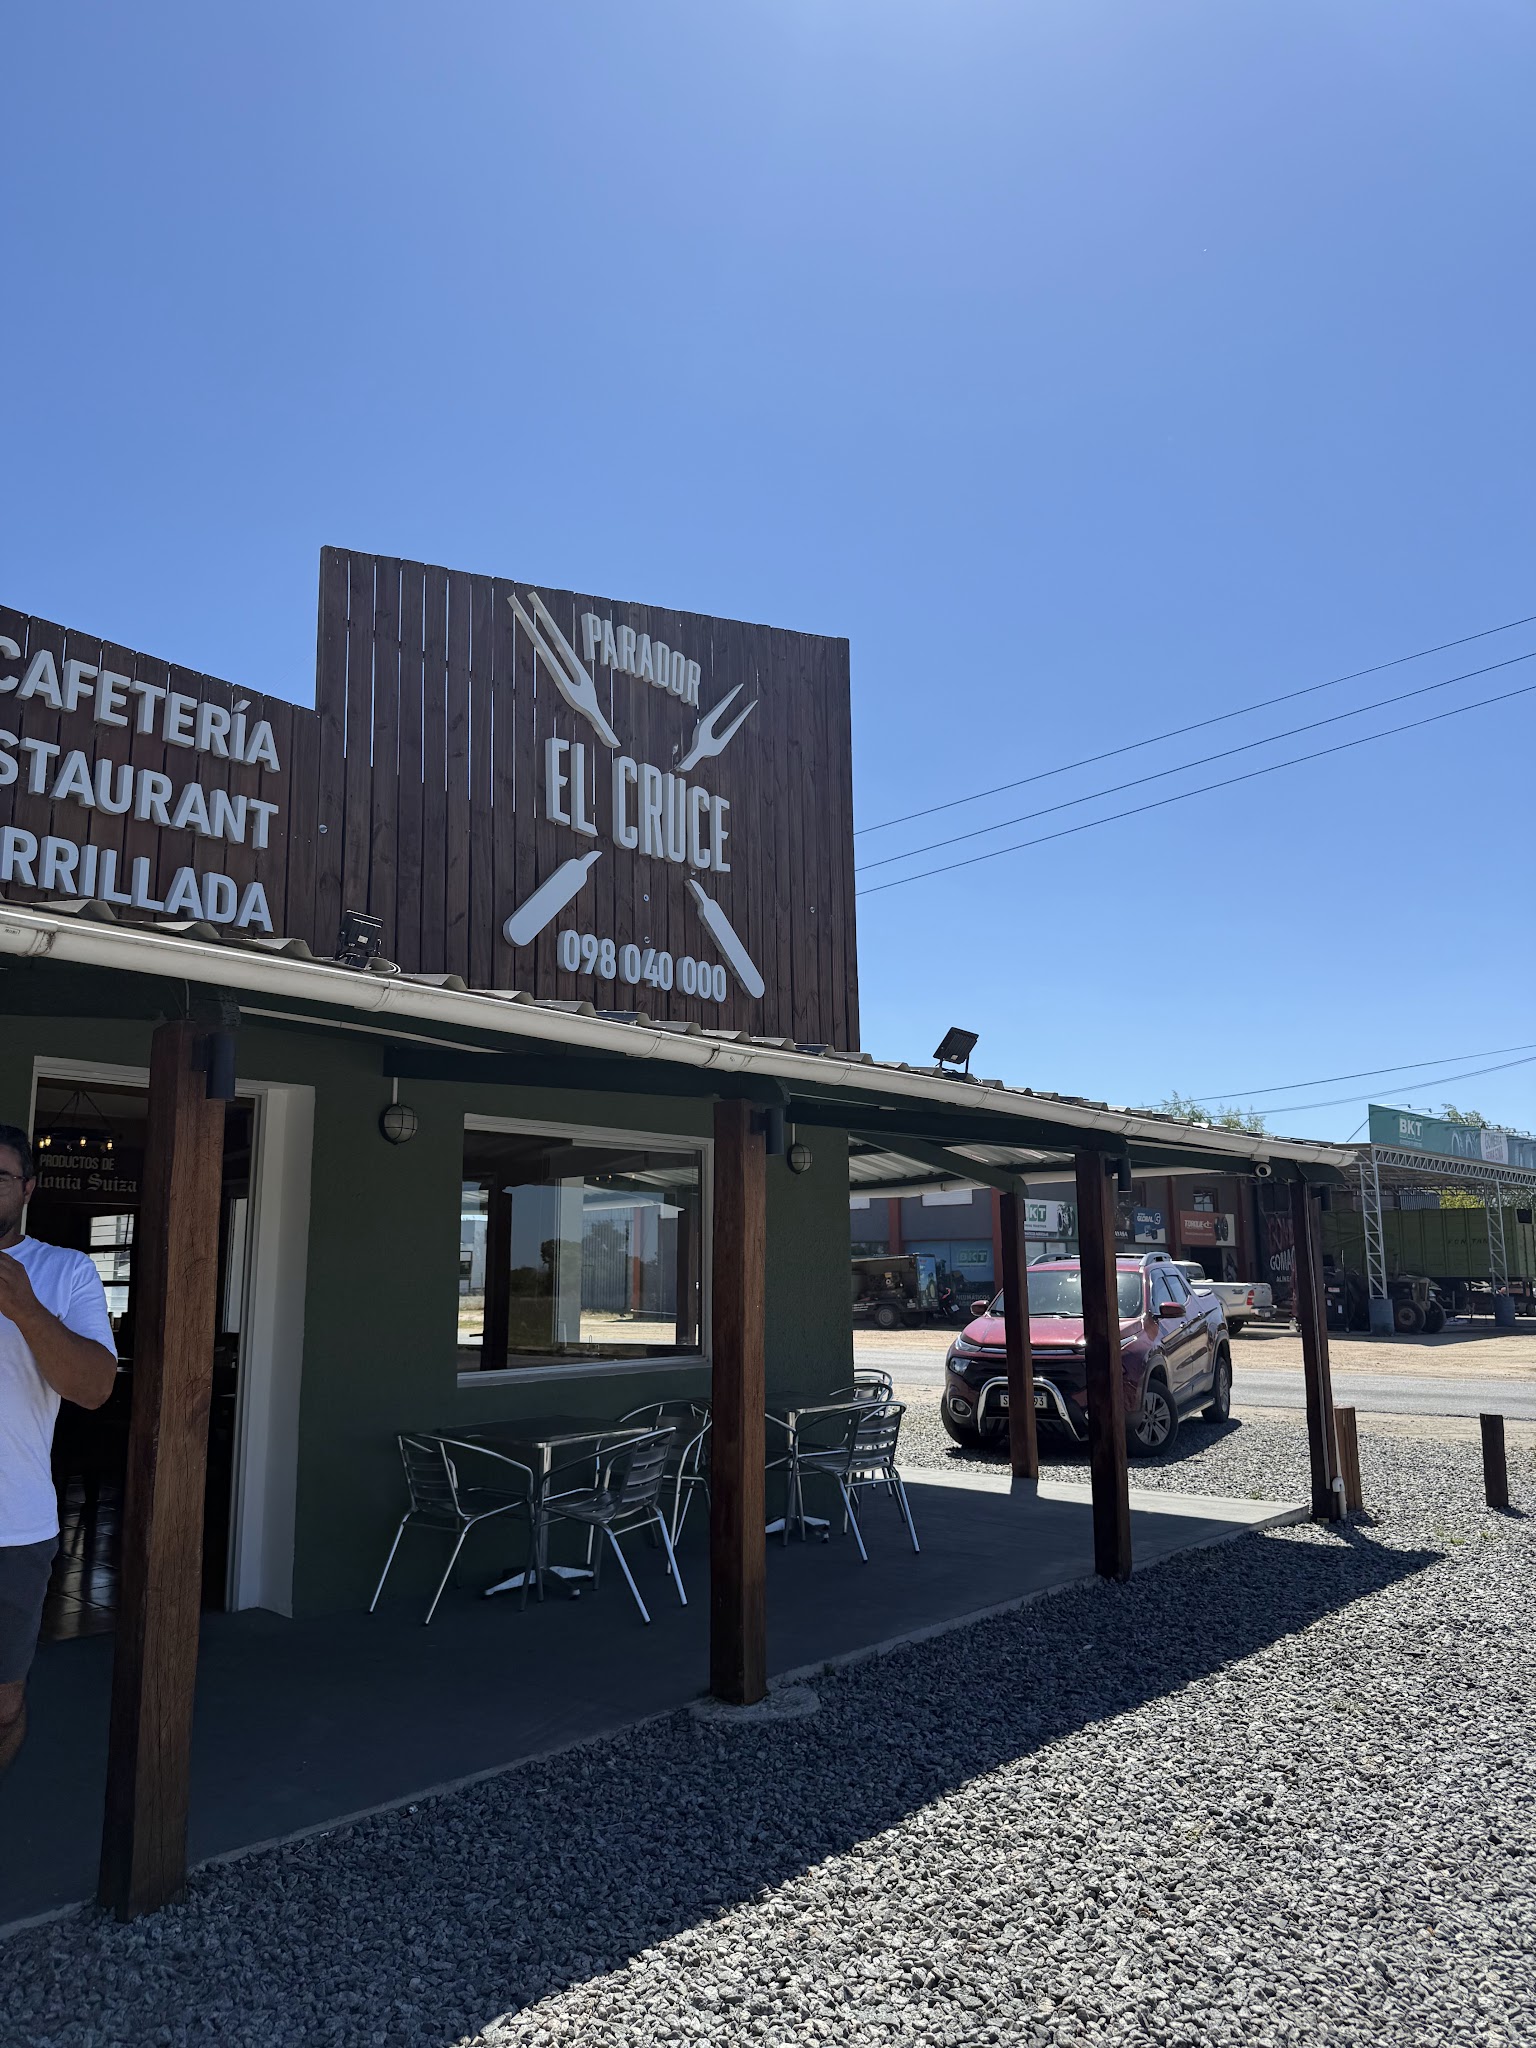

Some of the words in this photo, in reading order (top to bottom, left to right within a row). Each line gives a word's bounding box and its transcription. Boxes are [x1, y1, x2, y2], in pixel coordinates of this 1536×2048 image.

[581, 612, 700, 708] PARADOR
[545, 737, 598, 837] EL
[612, 755, 730, 873] CRUCE
[557, 929, 616, 980] 098
[618, 943, 673, 992] 040
[676, 956, 727, 1003] 000
[1399, 1118, 1422, 1137] BKT
[40, 1154, 99, 1170] PRODUCTOS
[101, 1157, 115, 1171] DE
[87, 1173, 137, 1192] Suiza
[959, 1251, 987, 1262] BKT
